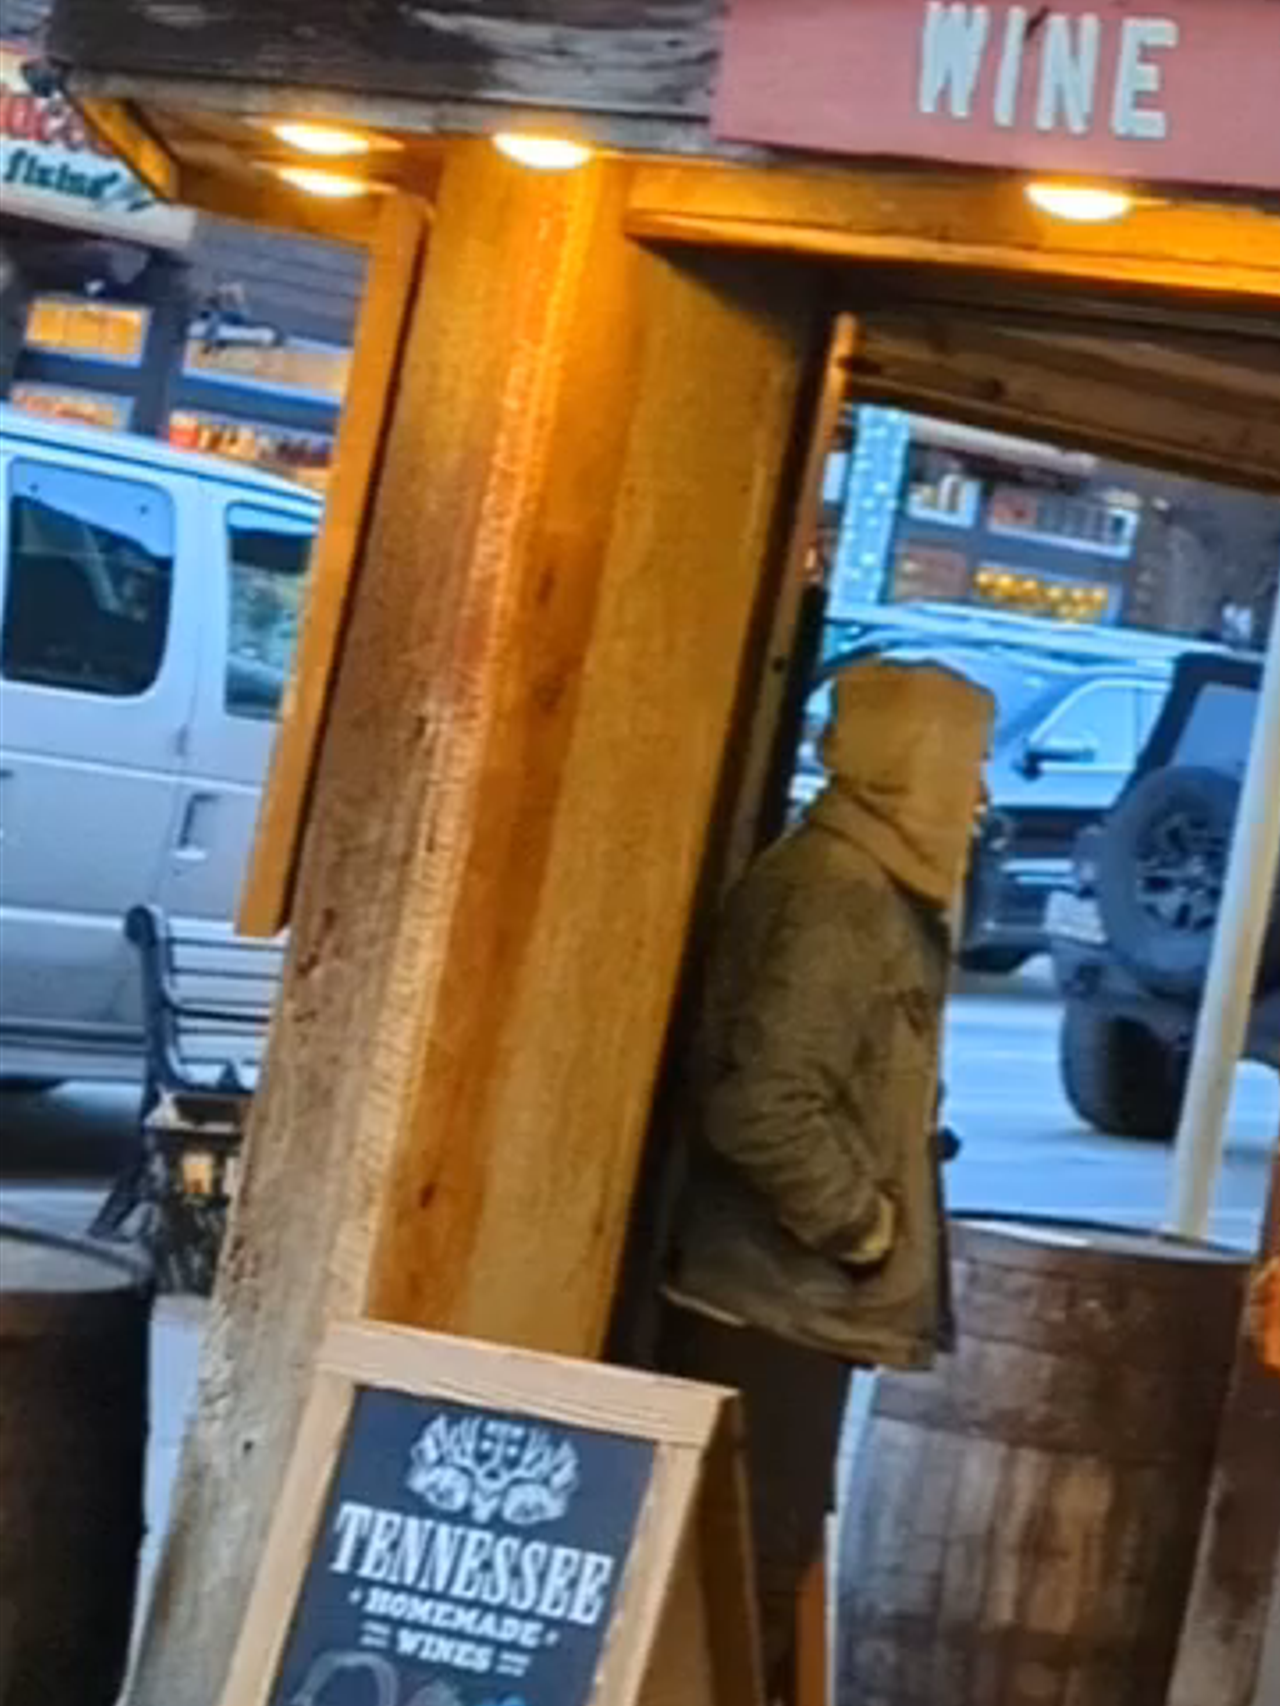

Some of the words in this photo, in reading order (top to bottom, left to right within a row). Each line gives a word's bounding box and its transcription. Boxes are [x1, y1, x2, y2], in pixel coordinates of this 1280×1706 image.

[916, 1, 1178, 141] WINE
[329, 1500, 615, 1626] TENNESSEE
[363, 1586, 544, 1648] HOMEMADE
[396, 1628, 495, 1673] WINES
